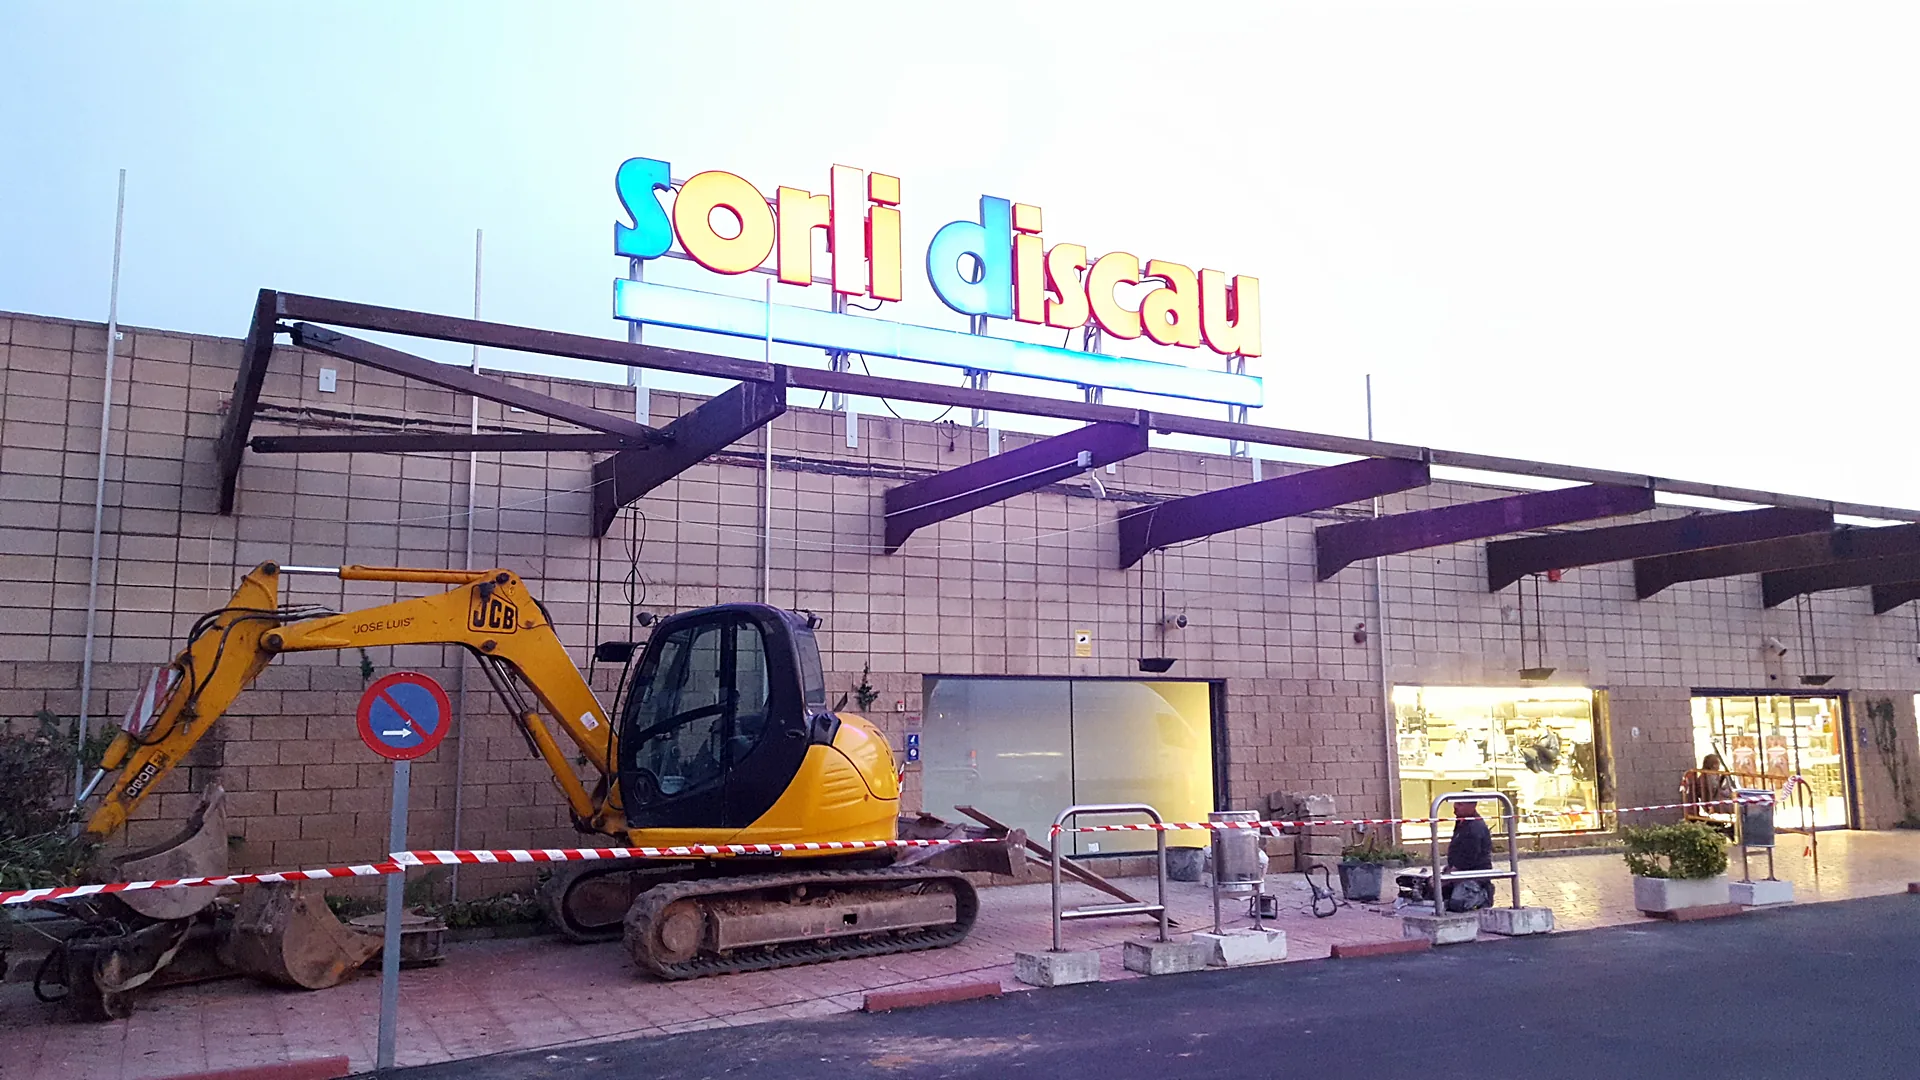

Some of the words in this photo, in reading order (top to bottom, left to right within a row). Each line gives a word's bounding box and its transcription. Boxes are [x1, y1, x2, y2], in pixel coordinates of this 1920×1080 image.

[614, 156, 902, 303] sorli
[926, 194, 1261, 359] discau
[473, 590, 514, 630] JCB
